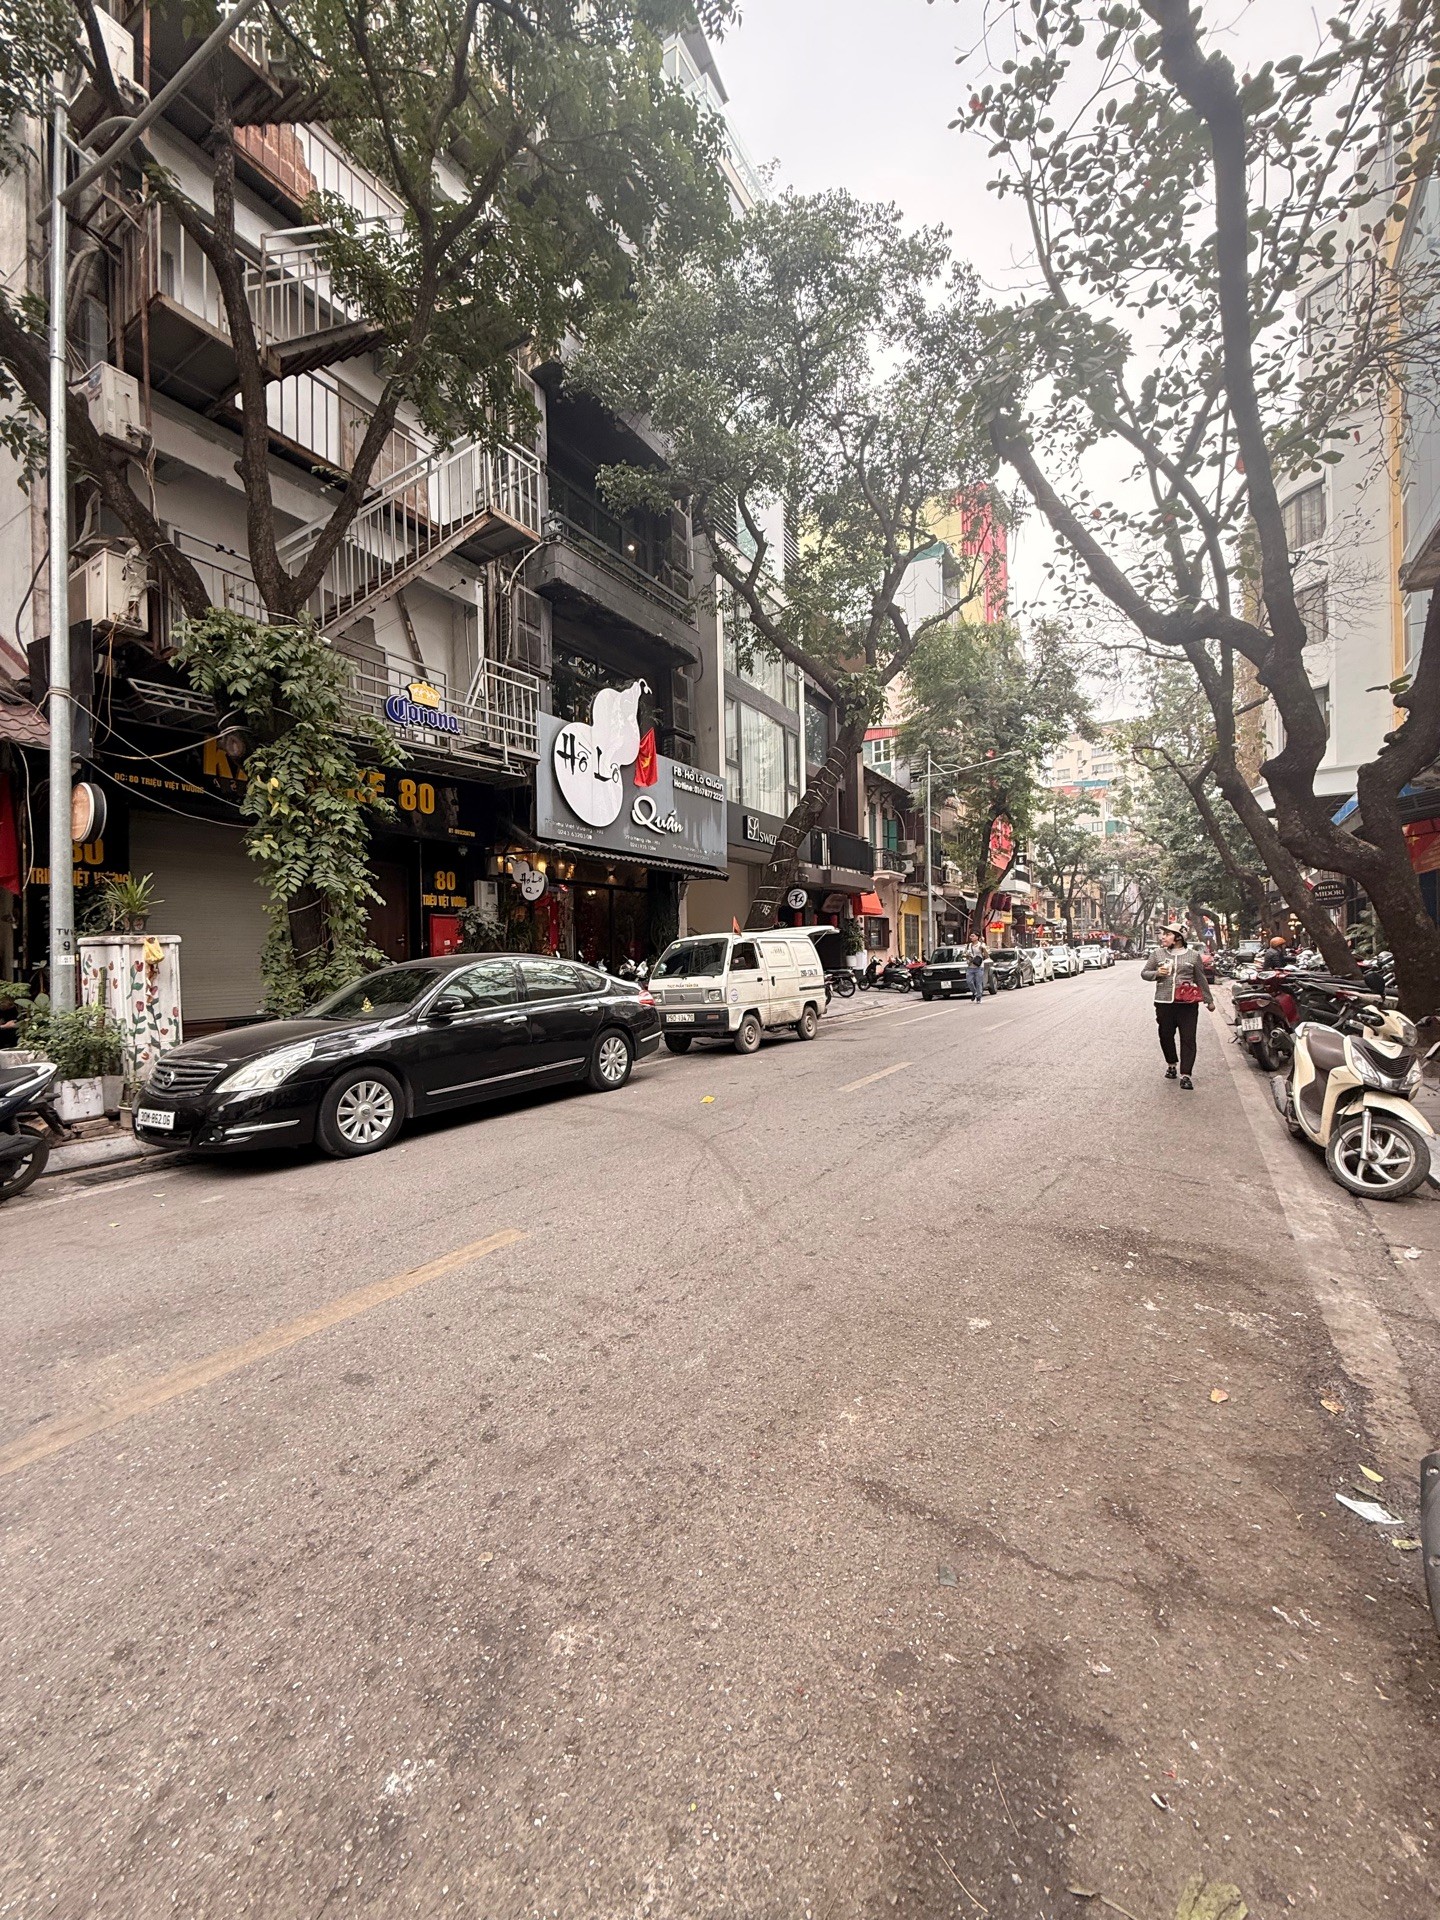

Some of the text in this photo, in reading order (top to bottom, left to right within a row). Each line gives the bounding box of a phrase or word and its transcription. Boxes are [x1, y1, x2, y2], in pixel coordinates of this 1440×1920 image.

[386, 694, 461, 733] Corona
[128, 775, 139, 783] 80
[398, 778, 435, 815] 80
[631, 795, 684, 834] Quán
[435, 870, 456, 891] 80
[1314, 889, 1345, 898] MIDORI
[63, 940, 71, 951] 9
